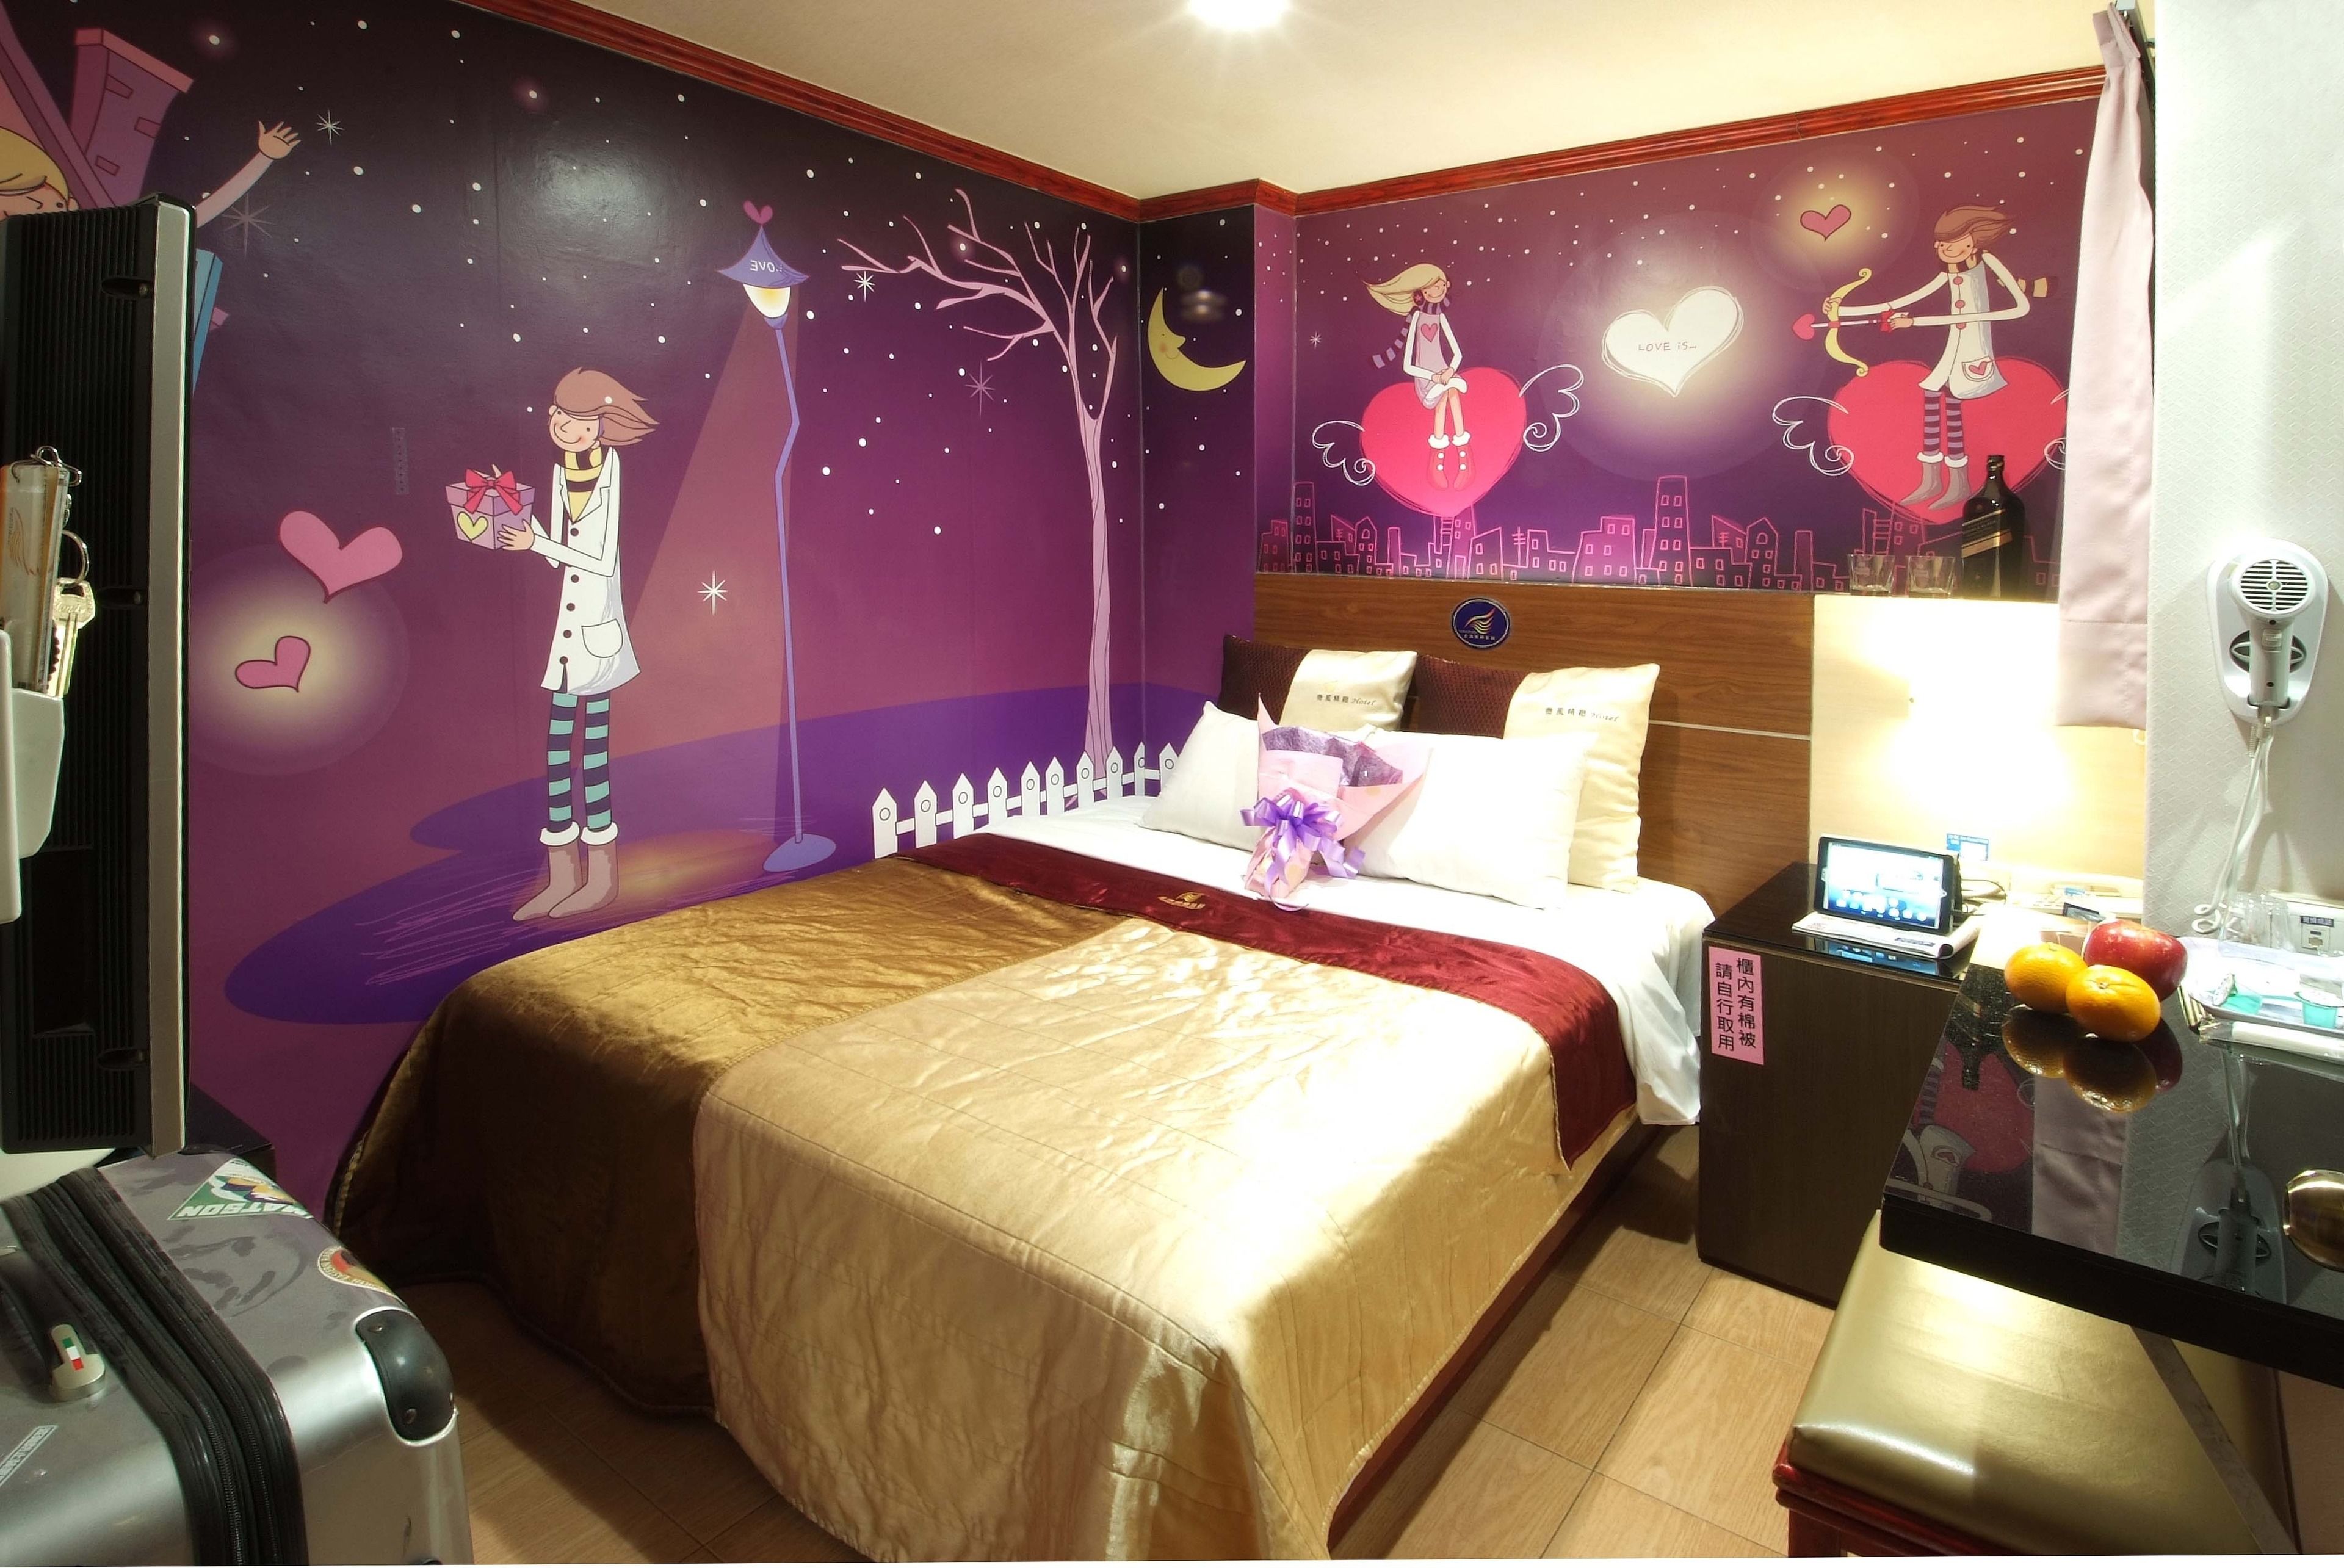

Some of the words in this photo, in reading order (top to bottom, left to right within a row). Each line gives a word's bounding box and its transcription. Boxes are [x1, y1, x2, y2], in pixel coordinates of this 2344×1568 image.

[1638, 342, 1671, 352] LOVE
[1715, 962, 1735, 1052] 請自行取用
